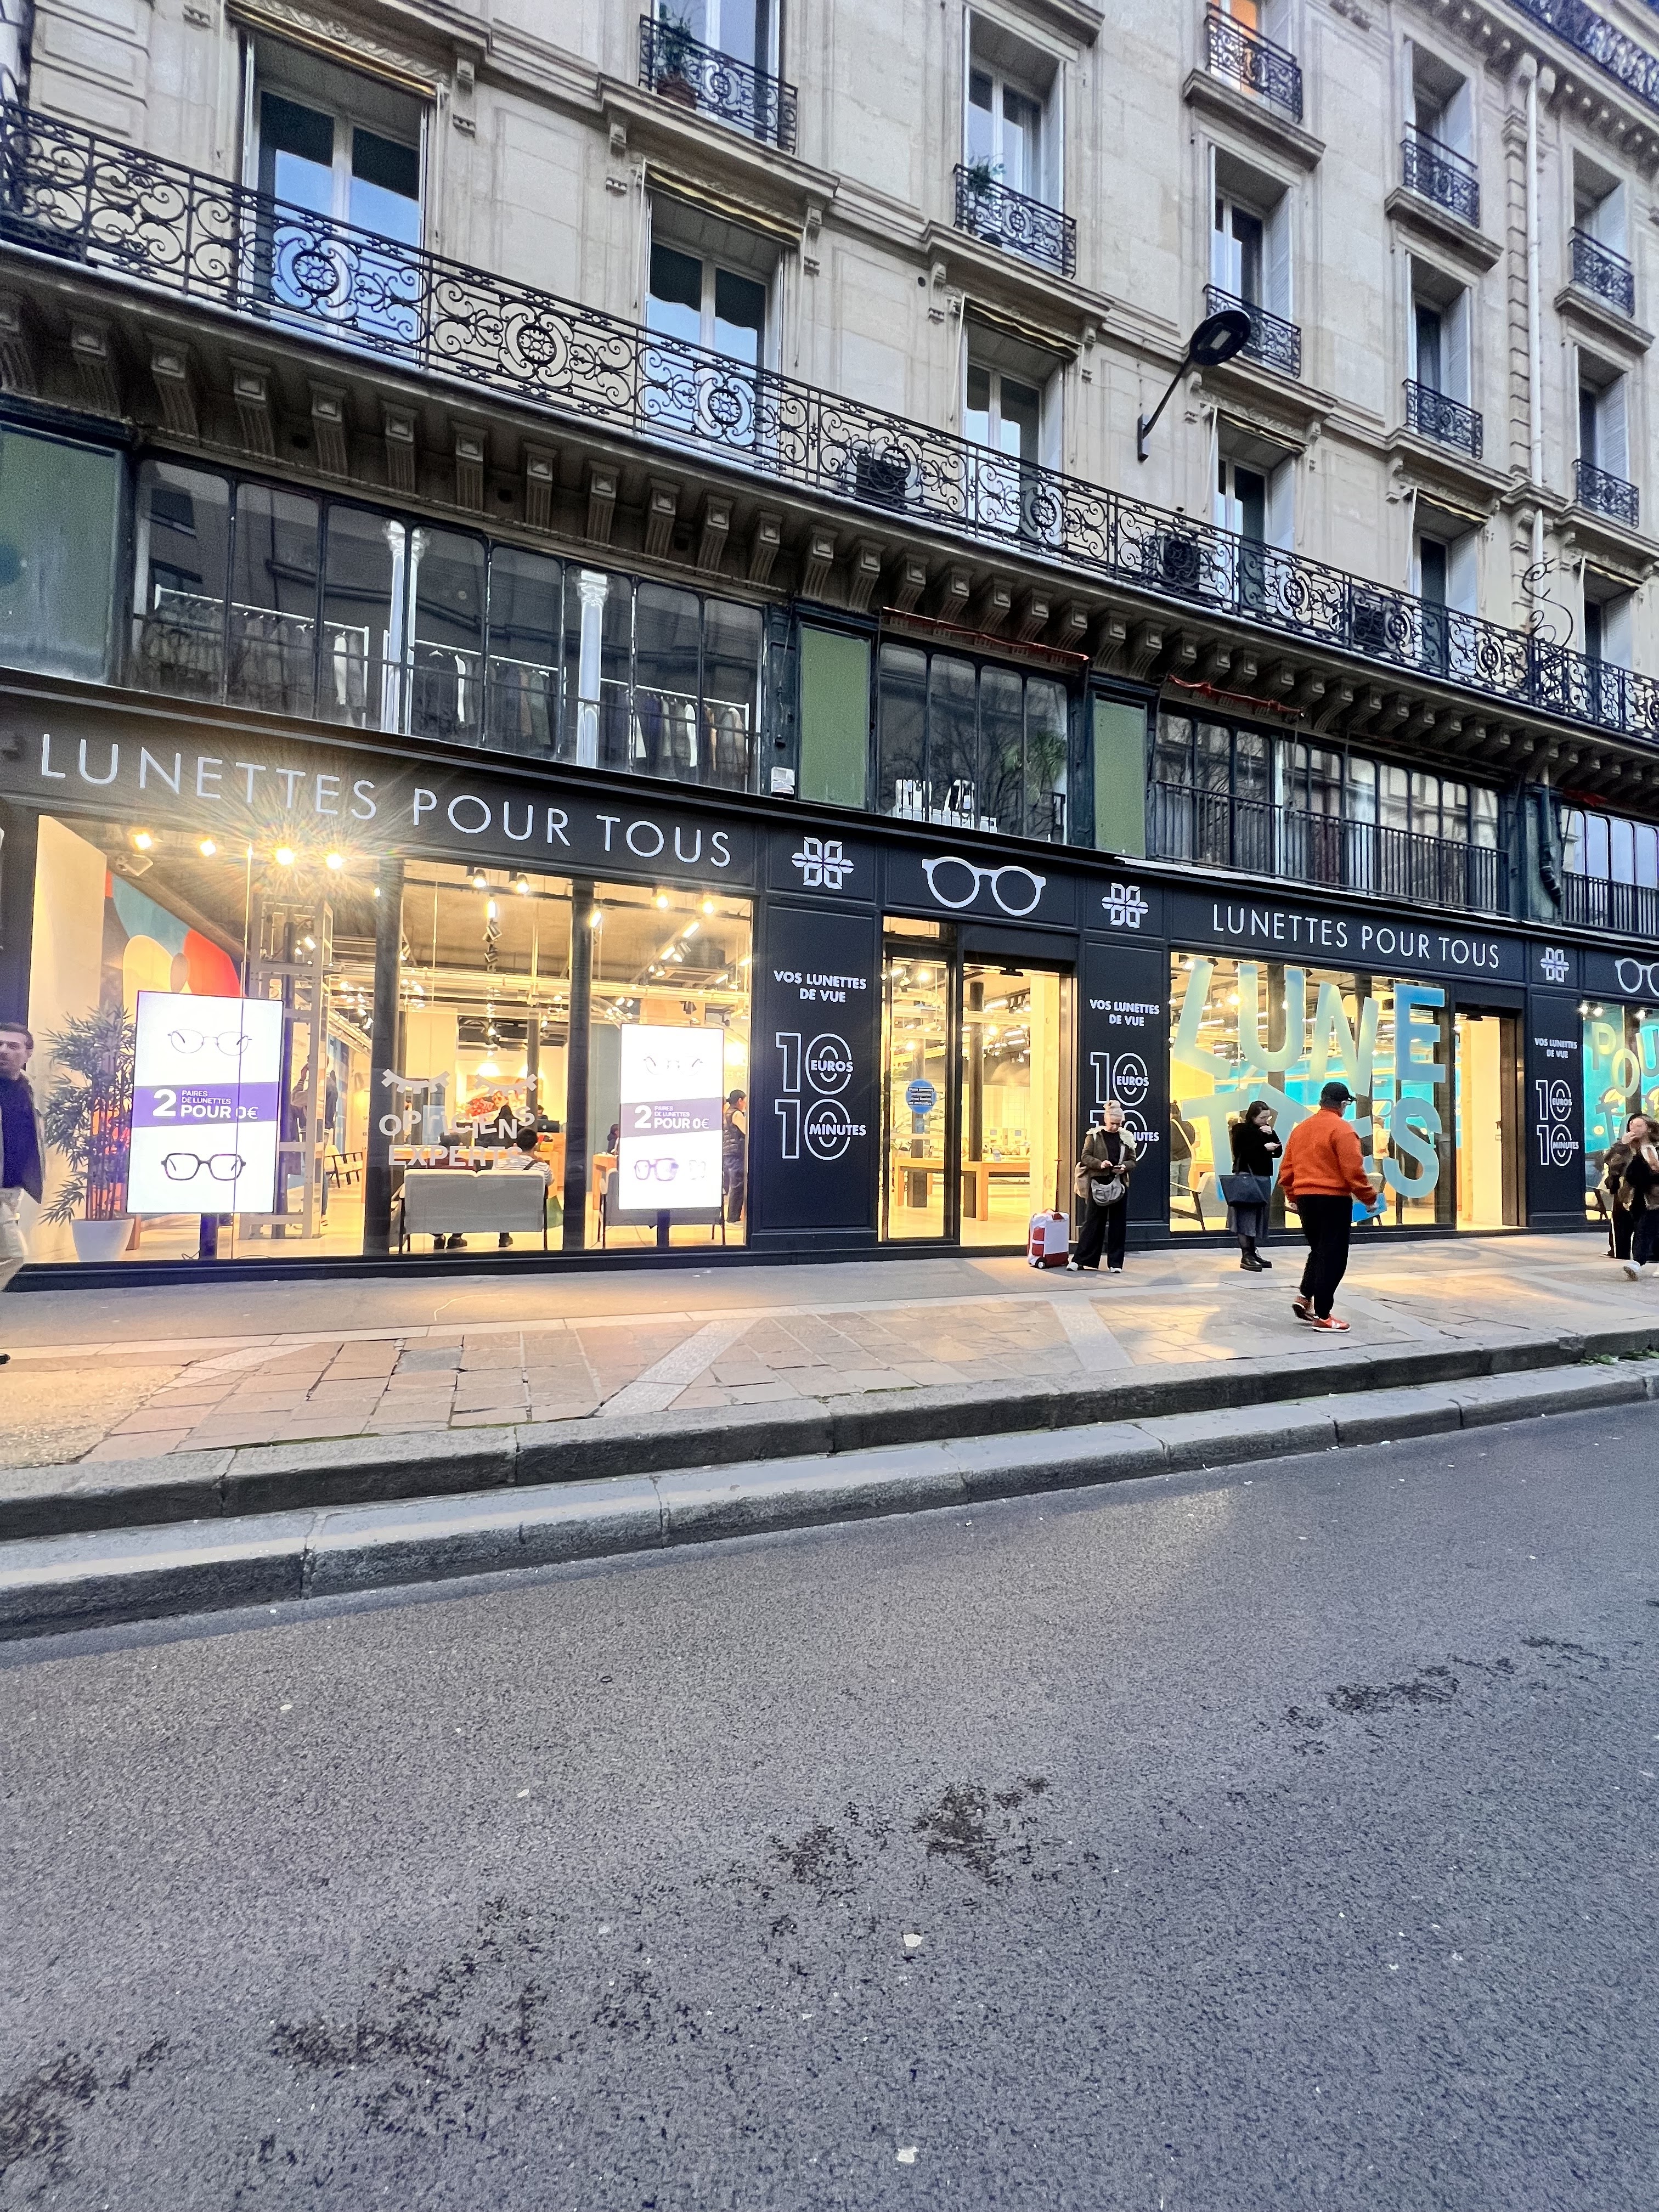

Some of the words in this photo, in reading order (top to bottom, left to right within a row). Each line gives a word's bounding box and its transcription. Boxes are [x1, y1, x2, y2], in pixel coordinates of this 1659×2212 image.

[41, 733, 377, 820] LUNETTES
[413, 788, 571, 847] POUR
[596, 814, 731, 867] TOUS
[1212, 904, 1347, 948] LUNETTES
[1362, 925, 1430, 960] POUR
[1438, 936, 1500, 968] TOUS
[773, 970, 803, 984] VOS
[806, 973, 867, 990] LUNETTES
[799, 988, 816, 1001] DE
[820, 990, 846, 1003] VUE
[1090, 999, 1111, 1011] VOS
[1114, 1002, 1160, 1015] LUNETTES
[1109, 1014, 1122, 1025] DE
[1124, 1015, 1144, 1026] VUE
[1172, 958, 1446, 1097] LUNE
[1534, 1037, 1548, 1047] VOS
[1546, 1049, 1555, 1057] DE
[1556, 1049, 1568, 1058] VUE
[776, 1031, 853, 1095] 10
[810, 1059, 854, 1073] EUROS
[1090, 1051, 1148, 1107] 10
[1116, 1075, 1149, 1087] EUROS
[153, 1089, 177, 1116] 2
[1536, 1080, 1571, 1121] 10
[1552, 1098, 1572, 1106] EUROS
[180, 1104, 232, 1119] POUR
[235, 1106, 258, 1119] 0€
[634, 1105, 652, 1128] 2
[654, 1118, 691, 1129] POUR
[692, 1118, 709, 1129] 0€
[775, 1098, 851, 1161] 10
[809, 1124, 866, 1136] MINUTES
[1537, 1124, 1572, 1166] 10
[1553, 1141, 1579, 1149] MINUTES
[388, 1144, 523, 1170] EXPERTS
